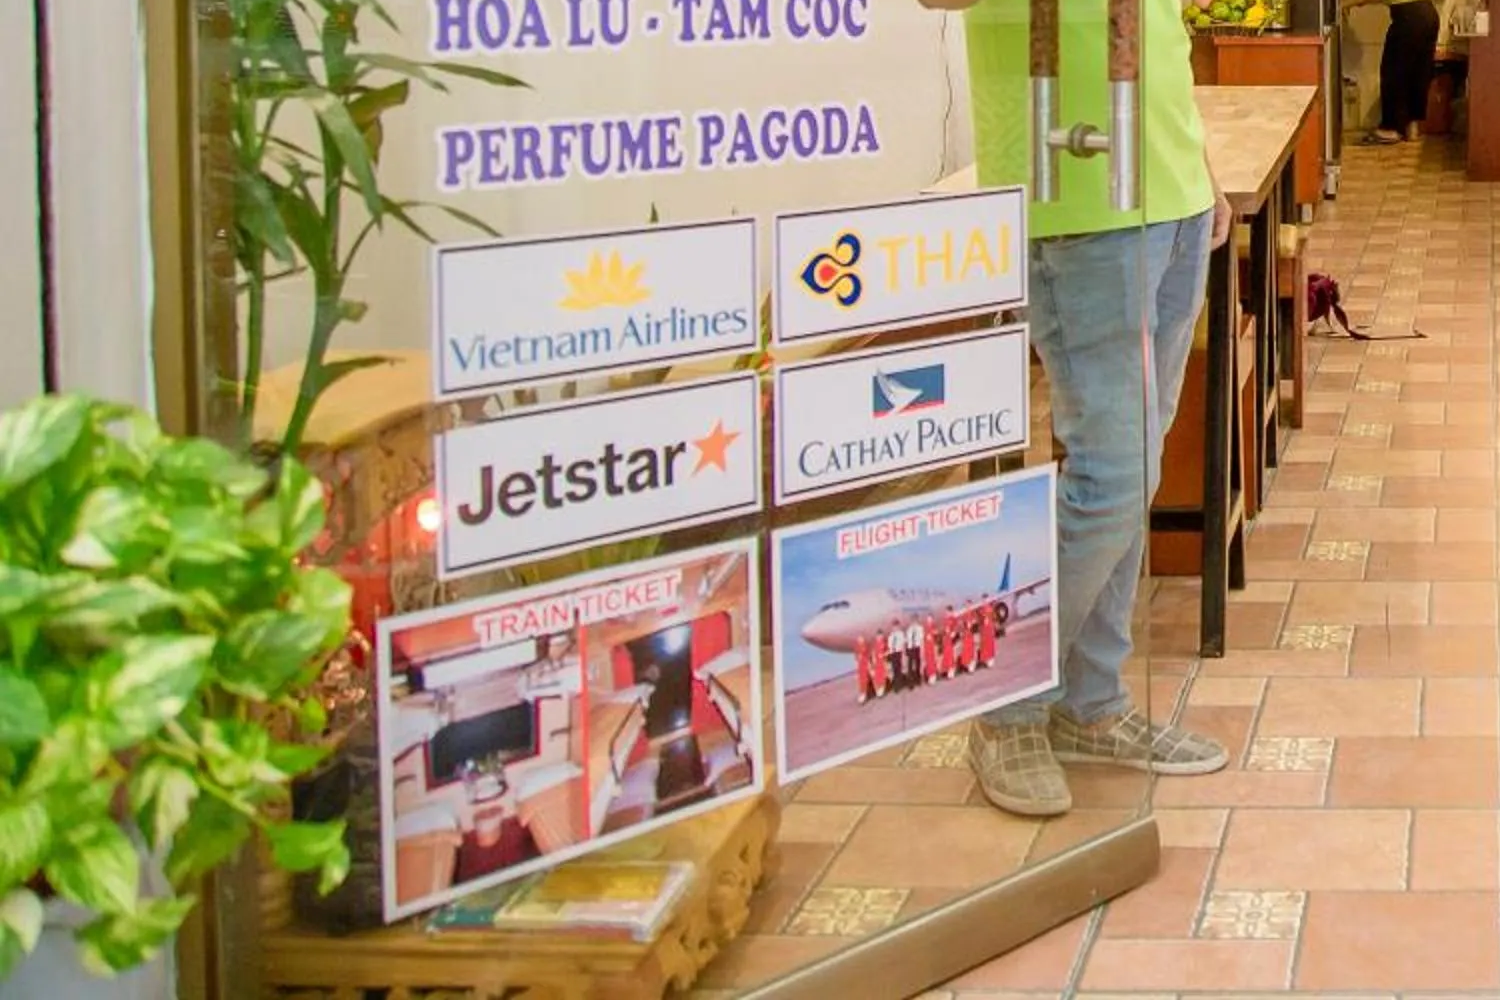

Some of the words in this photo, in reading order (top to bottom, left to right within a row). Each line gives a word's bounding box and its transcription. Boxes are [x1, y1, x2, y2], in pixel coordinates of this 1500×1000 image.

[442, 114, 683, 186] PERFUME
[698, 104, 880, 166] PAGODA
[878, 226, 1011, 294] THAI
[449, 320, 612, 374] Vietnam
[618, 304, 749, 347] Airlines
[798, 427, 909, 480] CATHAY
[916, 408, 1012, 453] PACIFIC
[457, 436, 688, 527] Jetstar
[838, 514, 921, 554] FLIGHT
[925, 494, 1002, 533] TICKET
[479, 605, 571, 642] TRAIN
[579, 575, 679, 617] TICKET
